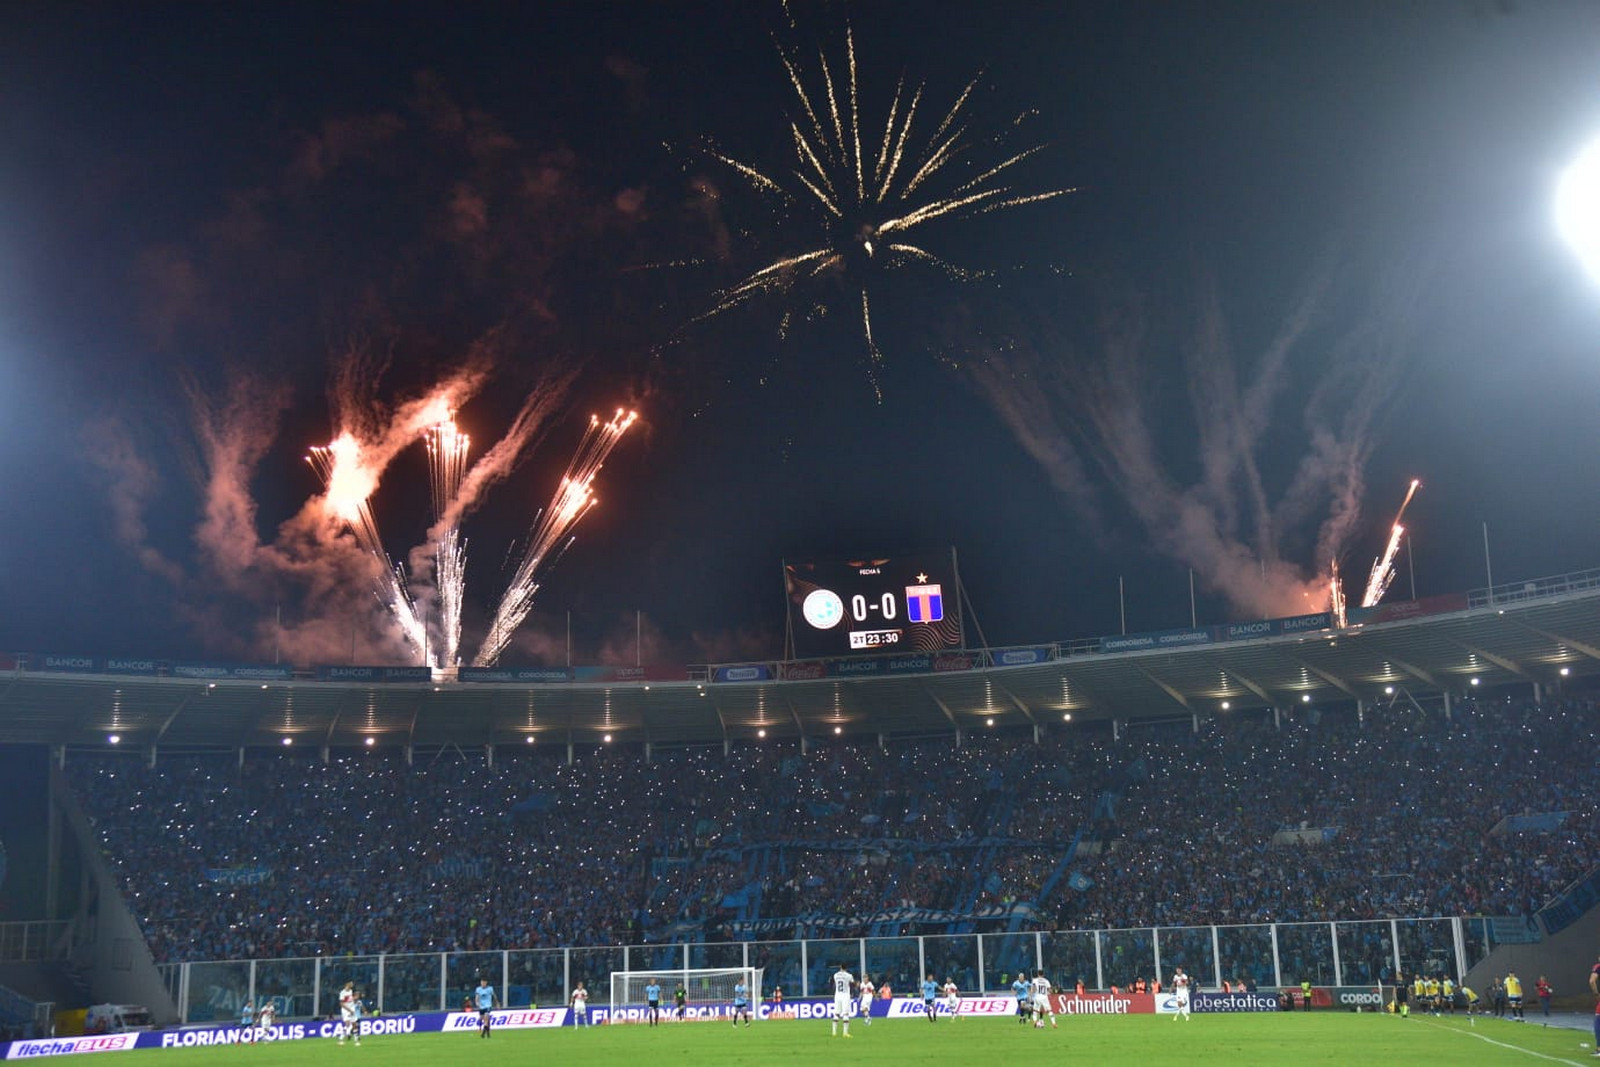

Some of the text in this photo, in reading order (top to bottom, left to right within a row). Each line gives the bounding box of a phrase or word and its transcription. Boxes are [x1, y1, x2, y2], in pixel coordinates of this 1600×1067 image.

[1230, 615, 1326, 636] BANCOR BANCOR
[867, 633, 899, 645] 23:30
[46, 657, 153, 671] BANCOR BANCOR
[839, 659, 929, 671] BANCOR BANCOR
[331, 668, 426, 677] BANCOR BANCOR
[837, 980, 844, 992] 2
[1038, 984, 1047, 995] 10
[758, 999, 857, 1019] CAMBORÚ
[1058, 994, 1131, 1014] Schneider
[1193, 994, 1276, 1012] pbestatica
[18, 1037, 127, 1056] flechaBUS
